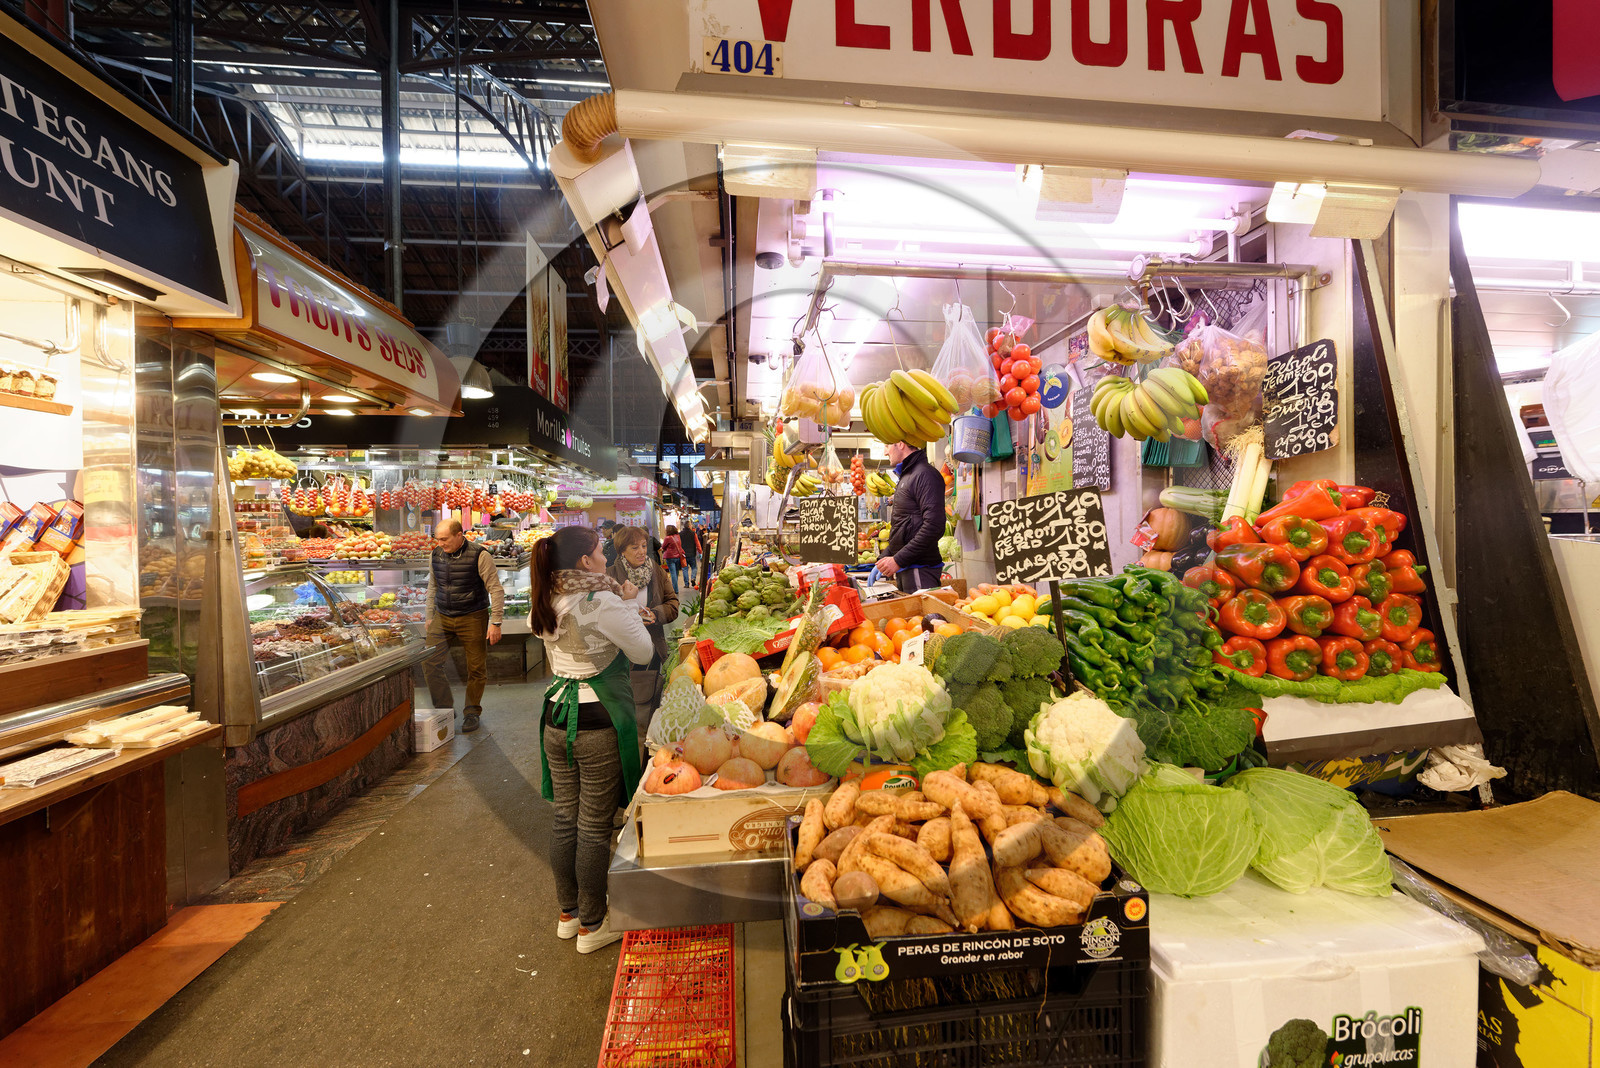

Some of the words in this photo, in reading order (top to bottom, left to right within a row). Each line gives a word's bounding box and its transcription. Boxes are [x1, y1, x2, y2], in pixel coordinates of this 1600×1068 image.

[711, 39, 774, 76] 404
[262, 262, 372, 352] FRUITS
[375, 326, 427, 379] SECS
[536, 408, 566, 446] Morilla
[572, 429, 592, 458] fruites
[898, 944, 940, 956] PERAS
[943, 943, 960, 953] DE
[962, 938, 1011, 951] RINCÓN
[1014, 937, 1030, 948] DE
[1033, 935, 1066, 947] SOTO
[940, 952, 981, 965] Grandes
[983, 953, 996, 962] en
[998, 950, 1024, 960] sabor
[1335, 1009, 1420, 1042] Brócoli
[1344, 1047, 1414, 1068] grupolucas
